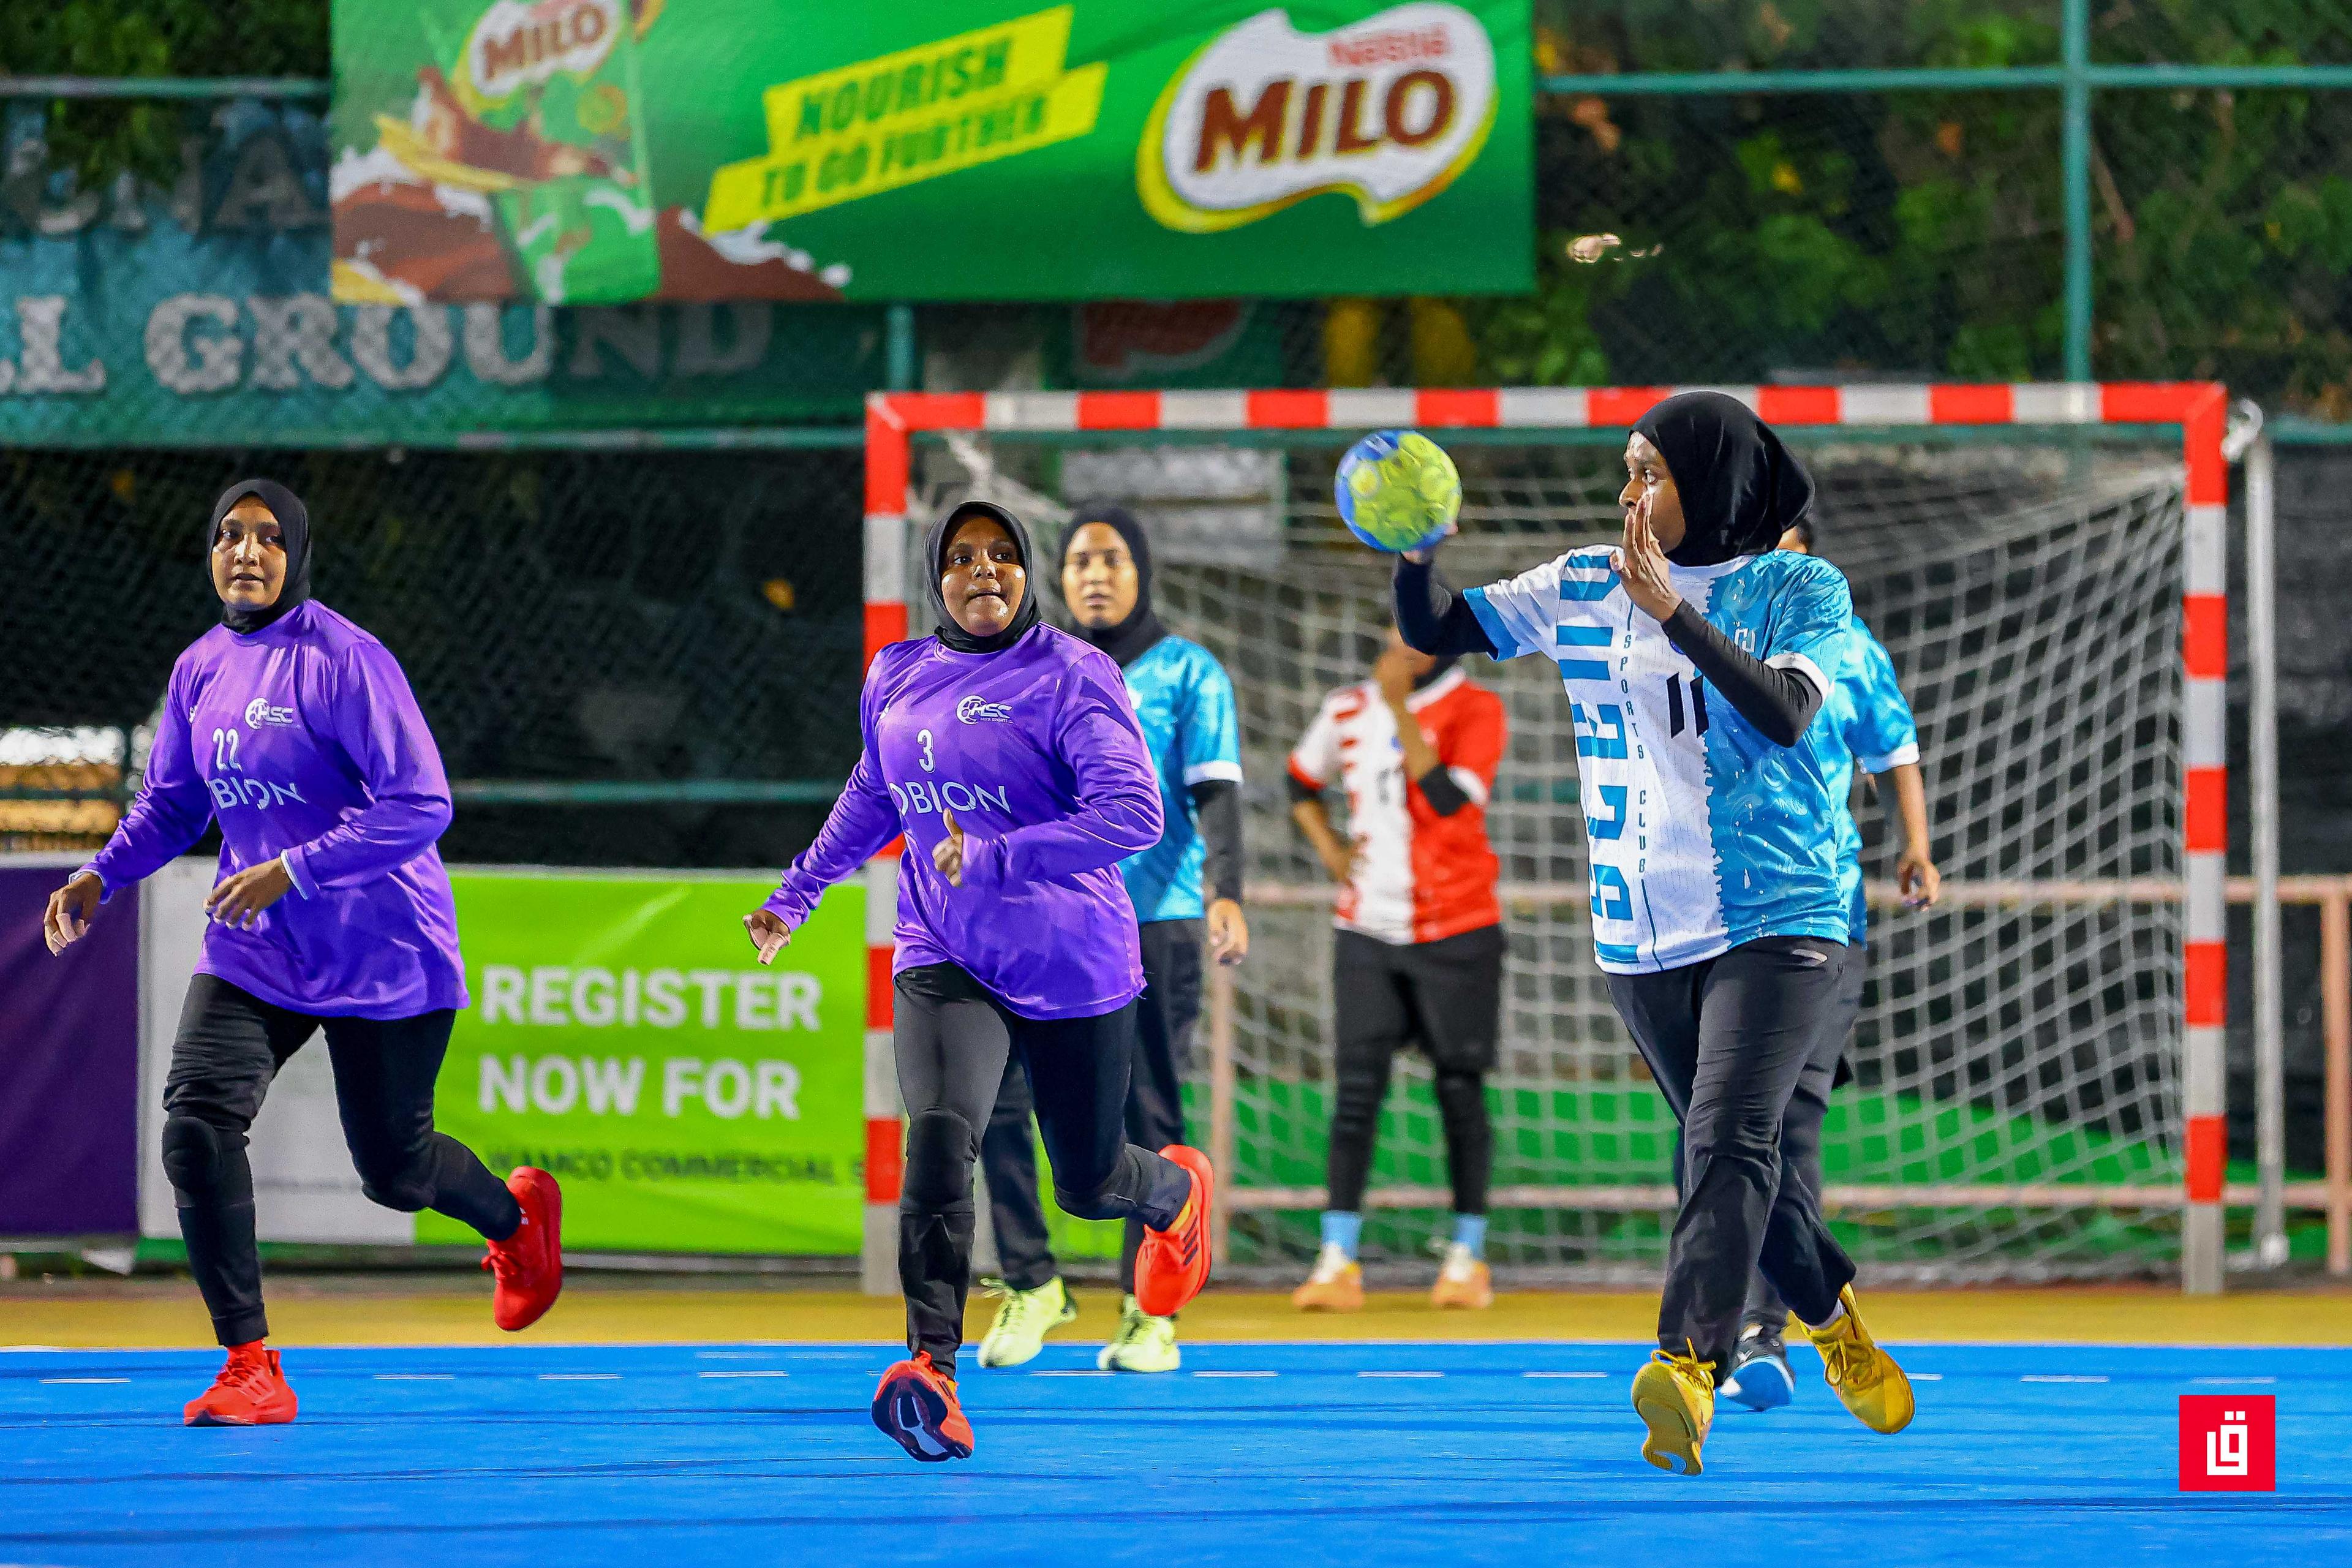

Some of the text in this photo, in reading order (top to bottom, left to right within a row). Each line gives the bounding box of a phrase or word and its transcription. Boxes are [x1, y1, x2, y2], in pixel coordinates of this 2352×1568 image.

[484, 3, 606, 81] MILO
[797, 37, 1014, 141] NOURISH
[1194, 70, 1455, 174] MILO
[761, 162, 806, 209] TO
[816, 144, 870, 193] GO
[0, 292, 773, 394] L GROUND
[1620, 635, 1644, 760] SPORTS
[1666, 672, 1709, 739] 11
[213, 727, 243, 772] 22
[917, 729, 935, 773] 3
[205, 776, 307, 810] BION
[481, 965, 822, 1032] REGISTER
[480, 1055, 800, 1119] NOW FOR
